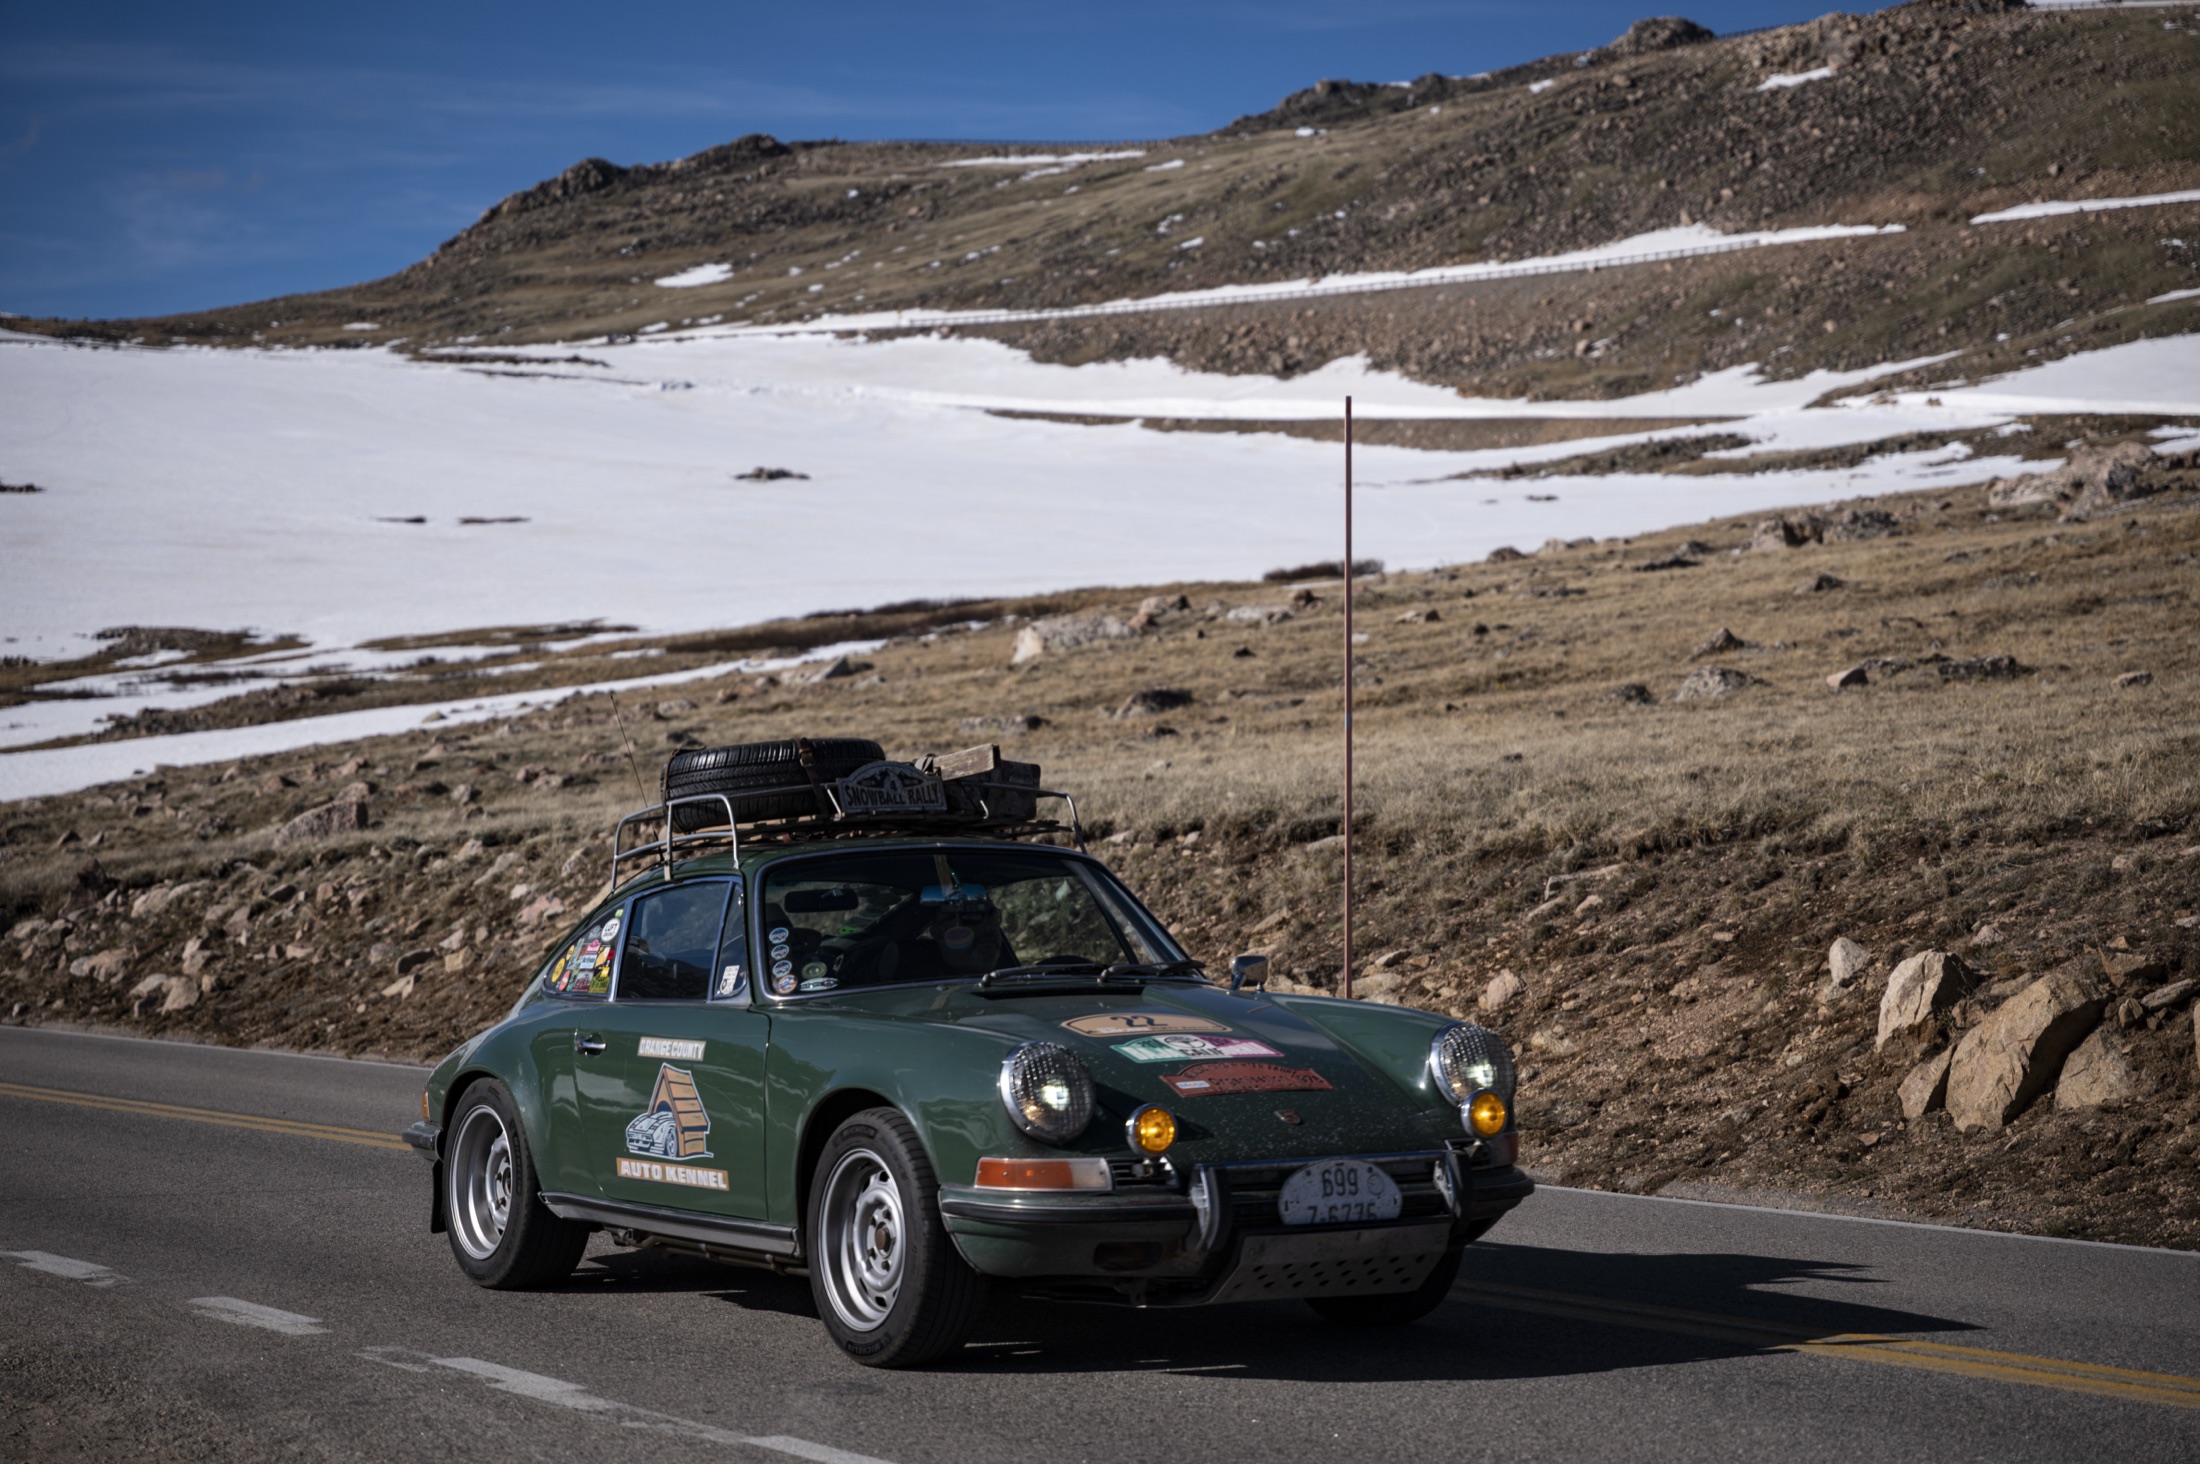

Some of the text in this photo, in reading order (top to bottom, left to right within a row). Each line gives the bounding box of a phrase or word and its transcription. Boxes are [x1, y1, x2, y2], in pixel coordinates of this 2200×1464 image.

[845, 783, 938, 806] SNOWBALL RALLY
[1110, 1015, 1168, 1027] 22
[639, 1039, 706, 1059] ORANGE COUNTY
[620, 1161, 727, 1189] AUTO KENNEL
